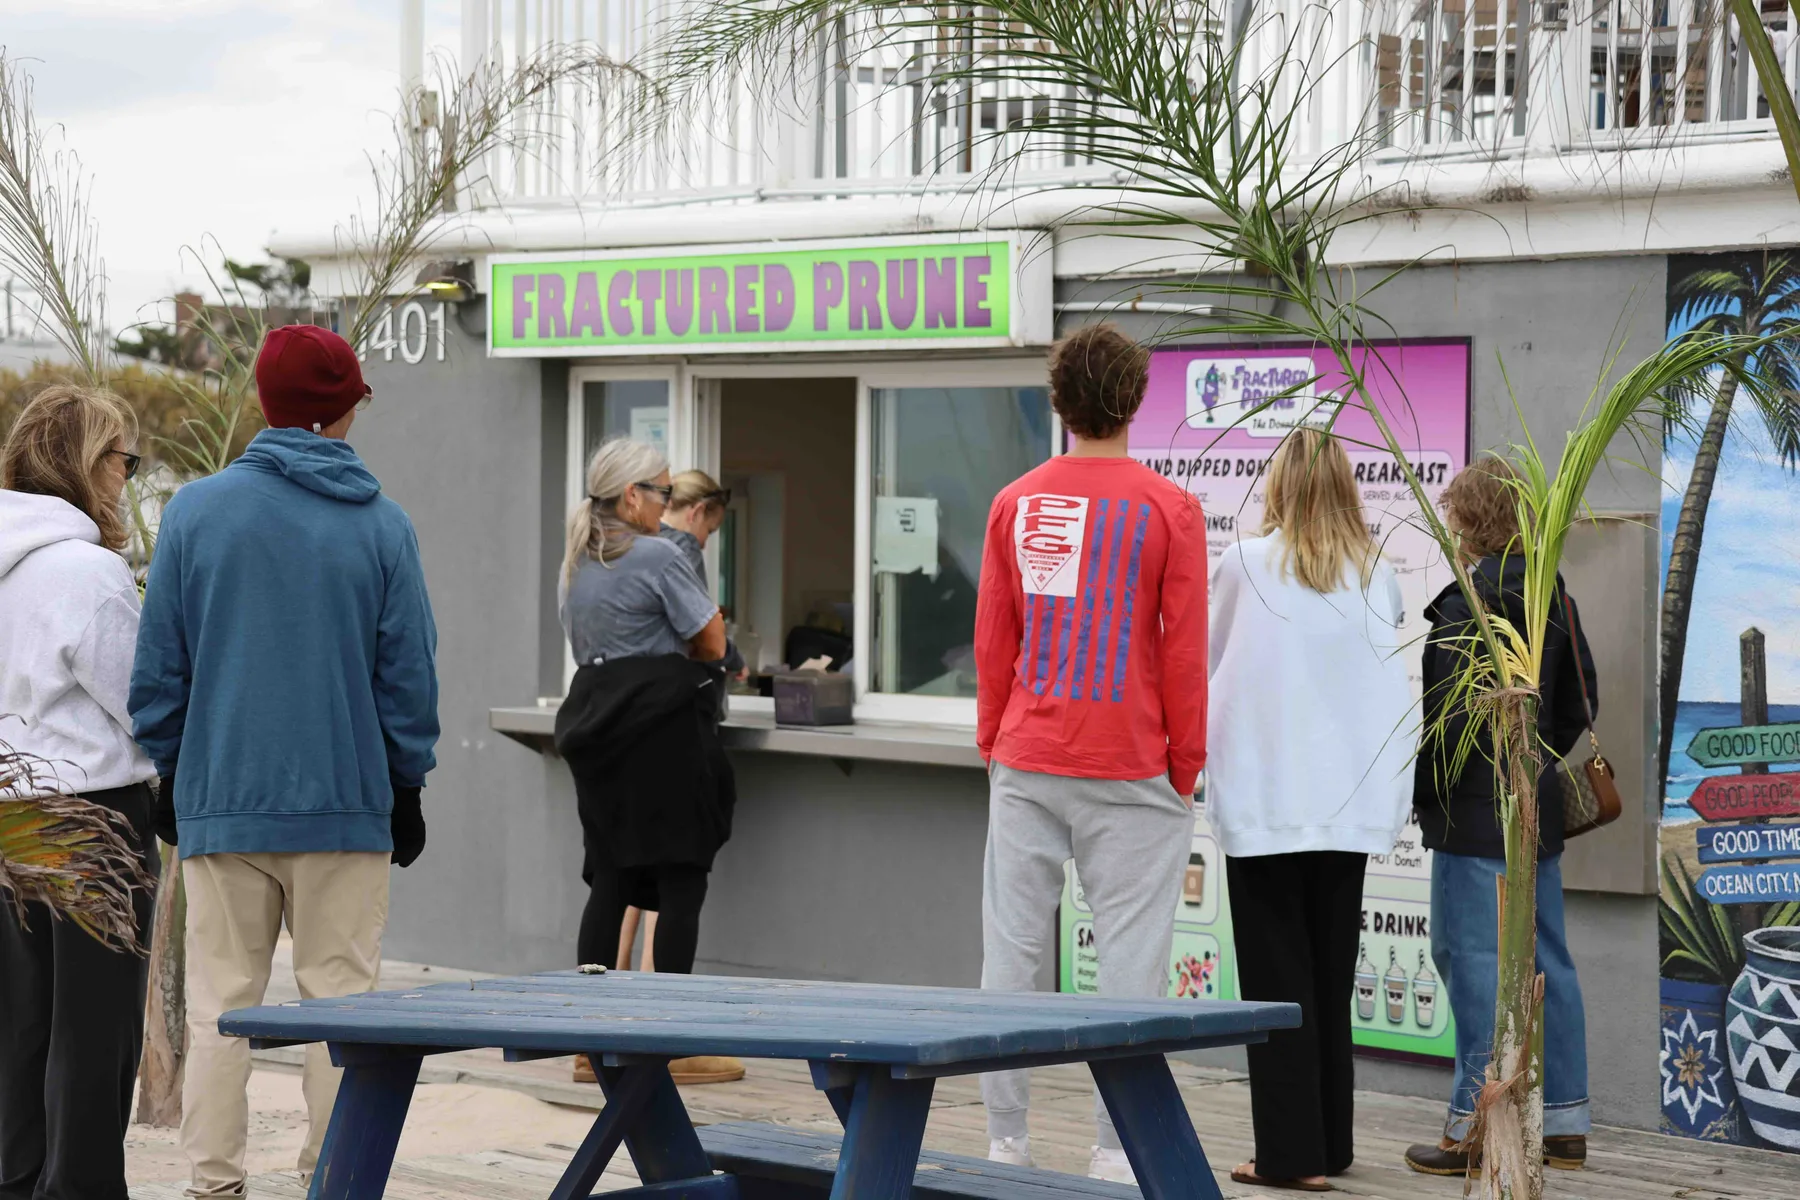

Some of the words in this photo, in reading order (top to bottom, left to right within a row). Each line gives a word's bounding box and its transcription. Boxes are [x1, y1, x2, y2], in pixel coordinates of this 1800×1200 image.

[512, 263, 796, 340] FRACTURED
[812, 254, 992, 332] PRUNE
[1231, 365, 1309, 390] FRACTURED
[1177, 458, 1231, 477] DIPPED
[1354, 461, 1448, 483] REAKAST
[1021, 496, 1082, 555] PFG
[1204, 515, 1234, 531] INGS
[1706, 733, 1756, 758] GOOD
[1704, 784, 1749, 811] GOOD
[1752, 781, 1800, 808] PEOPL
[1712, 830, 1760, 855] GOOD
[1705, 873, 1755, 897] OCEAN
[1755, 872, 1792, 894] CITY,
[1374, 911, 1431, 938] DRINK
